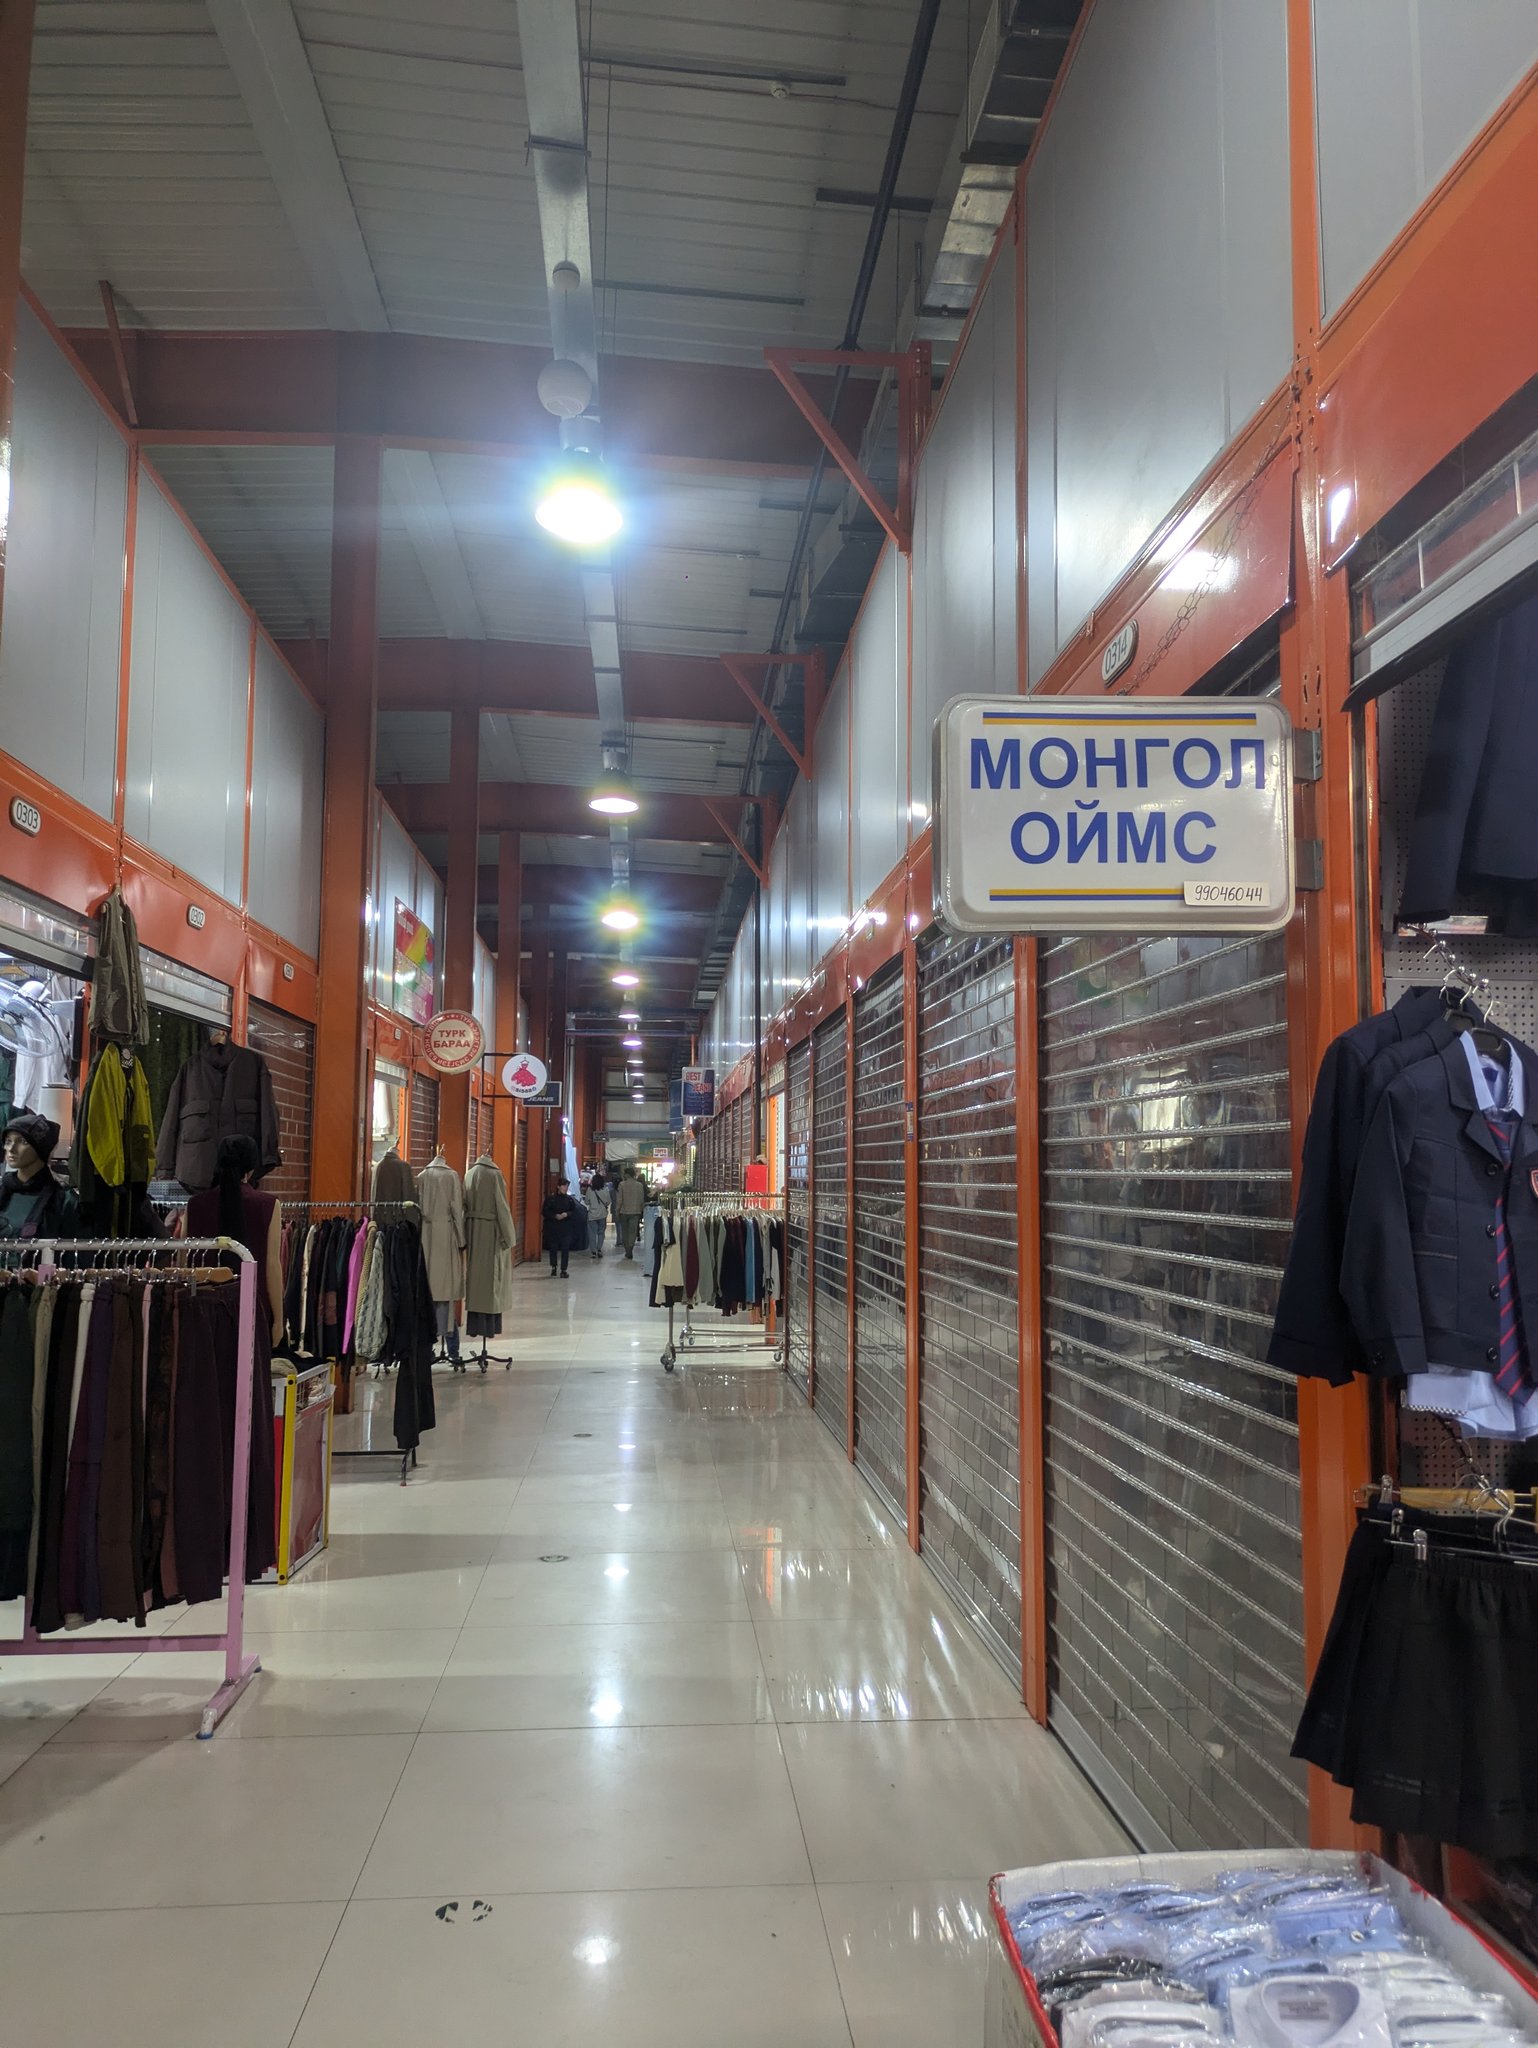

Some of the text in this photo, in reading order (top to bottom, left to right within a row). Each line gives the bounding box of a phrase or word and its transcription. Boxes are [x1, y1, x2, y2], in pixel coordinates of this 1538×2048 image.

[1105, 629, 1128, 675] 0314
[970, 737, 1266, 790] МОНГОЛ
[16, 802, 39, 829] 0303
[1010, 799, 1217, 865] ОЙМС
[1194, 884, 1263, 902] 99046044
[191, 907, 204, 927] 0302
[438, 1029, 466, 1037] ТУРК
[433, 1040, 470, 1048] БАРАА
[686, 1071, 702, 1081] BEST
